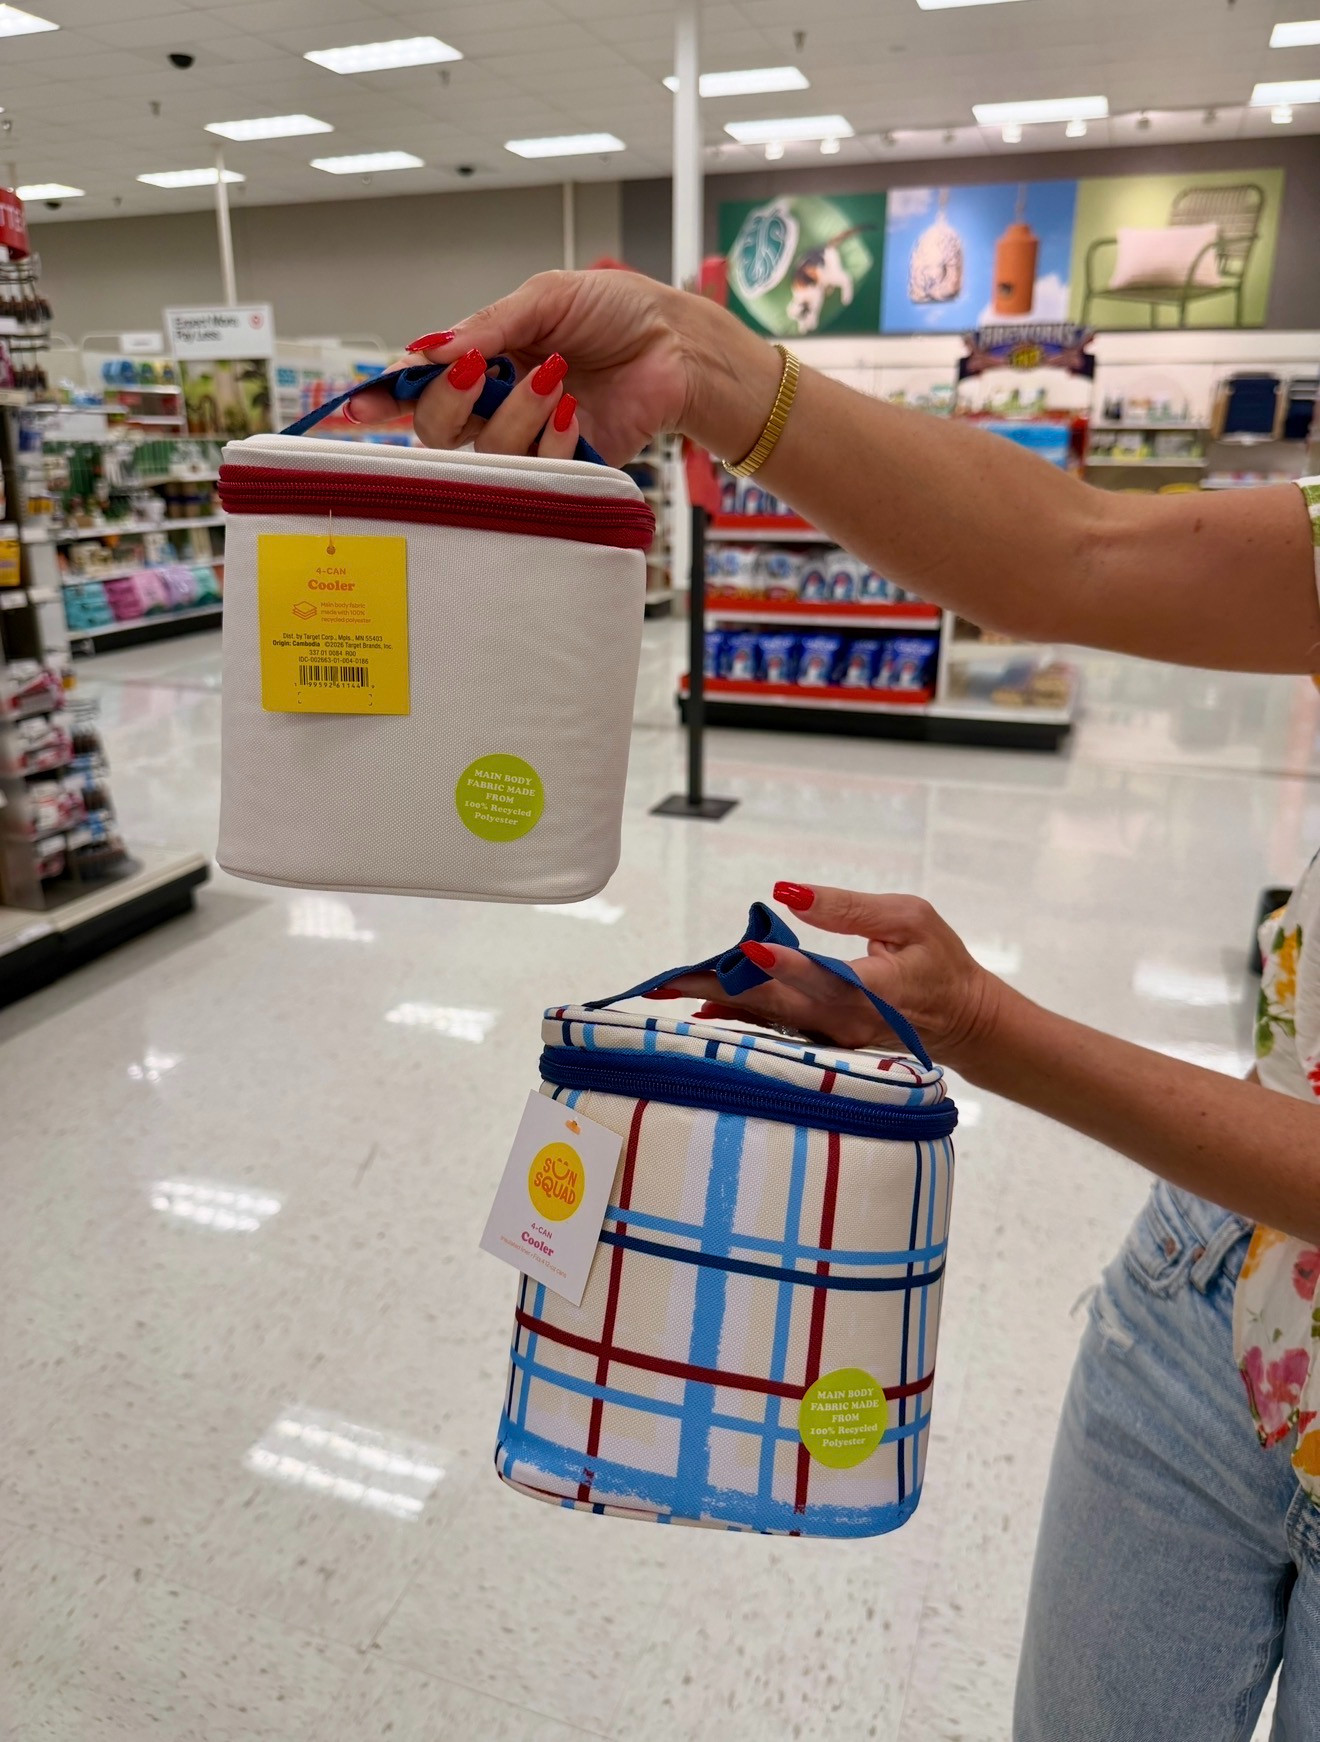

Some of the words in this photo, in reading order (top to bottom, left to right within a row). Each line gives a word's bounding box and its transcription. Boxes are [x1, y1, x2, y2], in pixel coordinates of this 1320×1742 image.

[316, 567, 346, 575] 4-CAN
[308, 579, 355, 591] Cooler
[475, 769, 502, 780] MAIN
[504, 774, 532, 785] BODY
[467, 778, 505, 792] FABRIC
[506, 785, 536, 797] MADE
[486, 792, 515, 804] FROM
[464, 800, 488, 810] 100%
[490, 804, 532, 817] Recycled
[474, 811, 518, 825] Polyester
[543, 1157, 578, 1188] SUN
[534, 1171, 576, 1205] SQUAD
[531, 1222, 553, 1239] 4-CAN
[521, 1231, 554, 1256] Cooler
[556, 1268, 567, 1278] cans
[817, 1390, 846, 1400] MAIN
[848, 1387, 874, 1398] BODY
[811, 1402, 849, 1411] FABRIC
[851, 1399, 880, 1410] MADE
[832, 1412, 860, 1423] FROM
[810, 1426, 835, 1435] 100%
[838, 1423, 878, 1435] Recycled
[822, 1438, 866, 1448] Polyester
